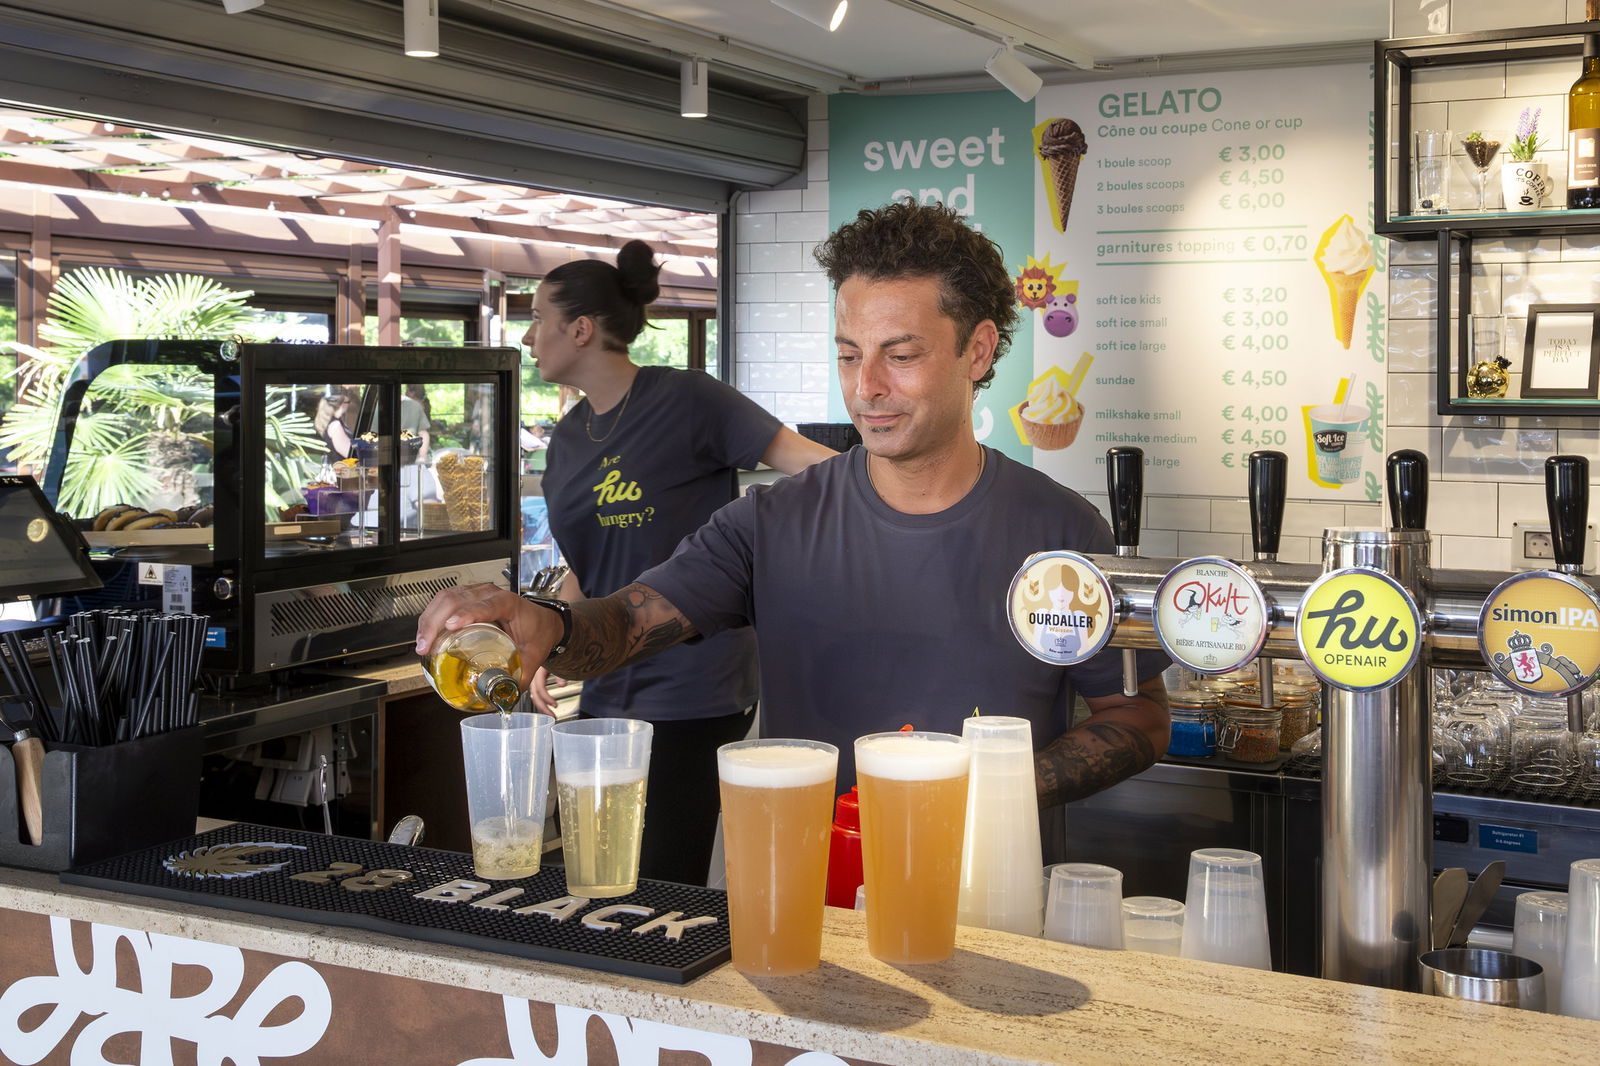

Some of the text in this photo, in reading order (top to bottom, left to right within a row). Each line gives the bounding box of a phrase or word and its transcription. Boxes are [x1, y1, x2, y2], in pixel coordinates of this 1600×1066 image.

[1098, 88, 1222, 118] GELATO
[1097, 117, 1303, 137] Cône ou coupe Cone or cup
[864, 127, 1005, 171] sweet
[1218, 144, 1285, 164] € 3,00
[1096, 156, 1171, 169] 1 boule scoop
[1097, 179, 1185, 191] 2 boules scoops
[1218, 168, 1285, 188] € 4,50
[1097, 202, 1185, 214] 3 boules scoops
[1218, 192, 1285, 212] € 6,00
[1097, 235, 1308, 257] garnitures topping € 0,70
[1096, 294, 1162, 305] soft ice kids
[1222, 287, 1287, 306] € 3,20
[1096, 317, 1168, 328] soft ice small
[1222, 310, 1288, 329] € 3,00
[1096, 341, 1167, 353] soft ice large
[1222, 334, 1288, 353] € 4,00
[1548, 338, 1578, 346] TODAY
[1095, 375, 1135, 385] sundae
[1221, 369, 1287, 389] € 4,50
[1095, 410, 1182, 420] milkshake small
[1221, 405, 1288, 424] € 4,00
[1095, 432, 1198, 444] milkshake medium
[1221, 429, 1287, 448] € 4,50
[1333, 434, 1345, 443] Ice
[598, 455, 621, 470] Are
[1152, 457, 1181, 469] large
[1221, 452, 1235, 468] €
[593, 469, 642, 506] hu
[597, 507, 655, 528] hungry?
[1196, 569, 1228, 578] BLANCHE
[1029, 613, 1093, 628] OURDALLER
[1307, 589, 1408, 652] hu
[1195, 640, 1234, 651] ARTISANALE
[1235, 642, 1246, 651] BIO
[1324, 653, 1387, 668] OPENAIR
[412, 878, 718, 942] BLACK
